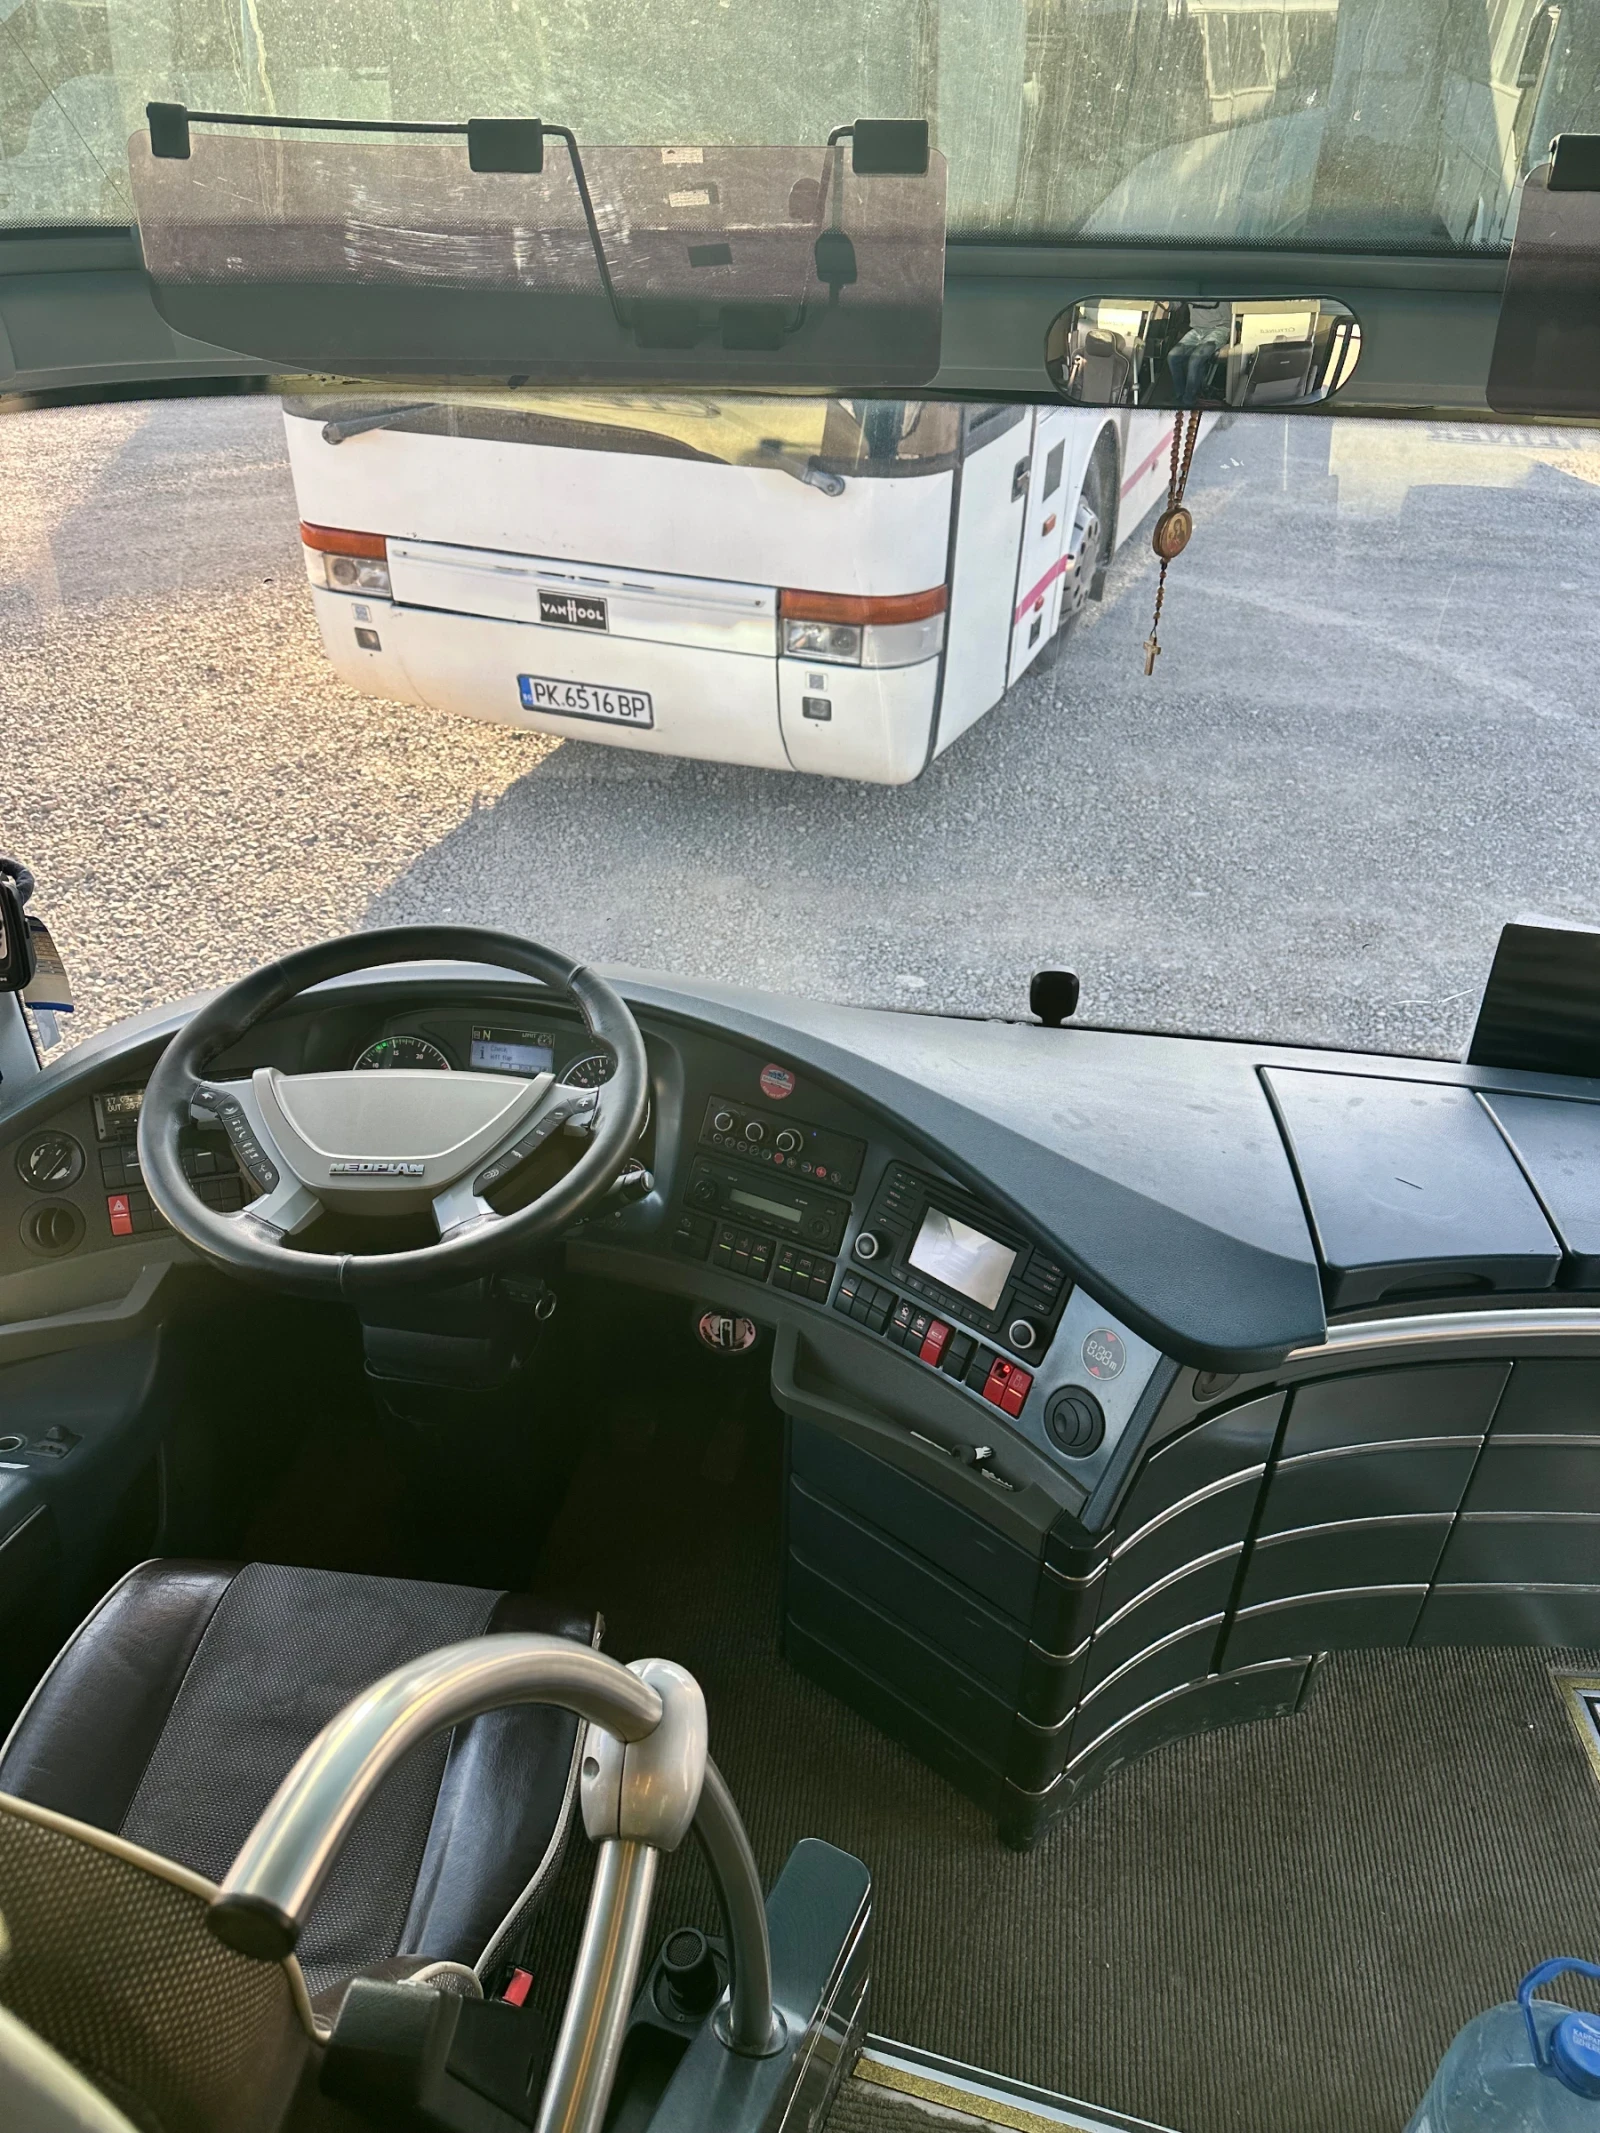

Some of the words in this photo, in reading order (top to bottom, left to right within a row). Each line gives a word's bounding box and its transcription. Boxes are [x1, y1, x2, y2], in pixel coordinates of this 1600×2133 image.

[565, 687, 614, 713] 6516
[617, 695, 645, 718] BP
[482, 1030, 491, 1041] N
[329, 1162, 424, 1175] NEOPLAN
[756, 1245, 767, 1253] WC
